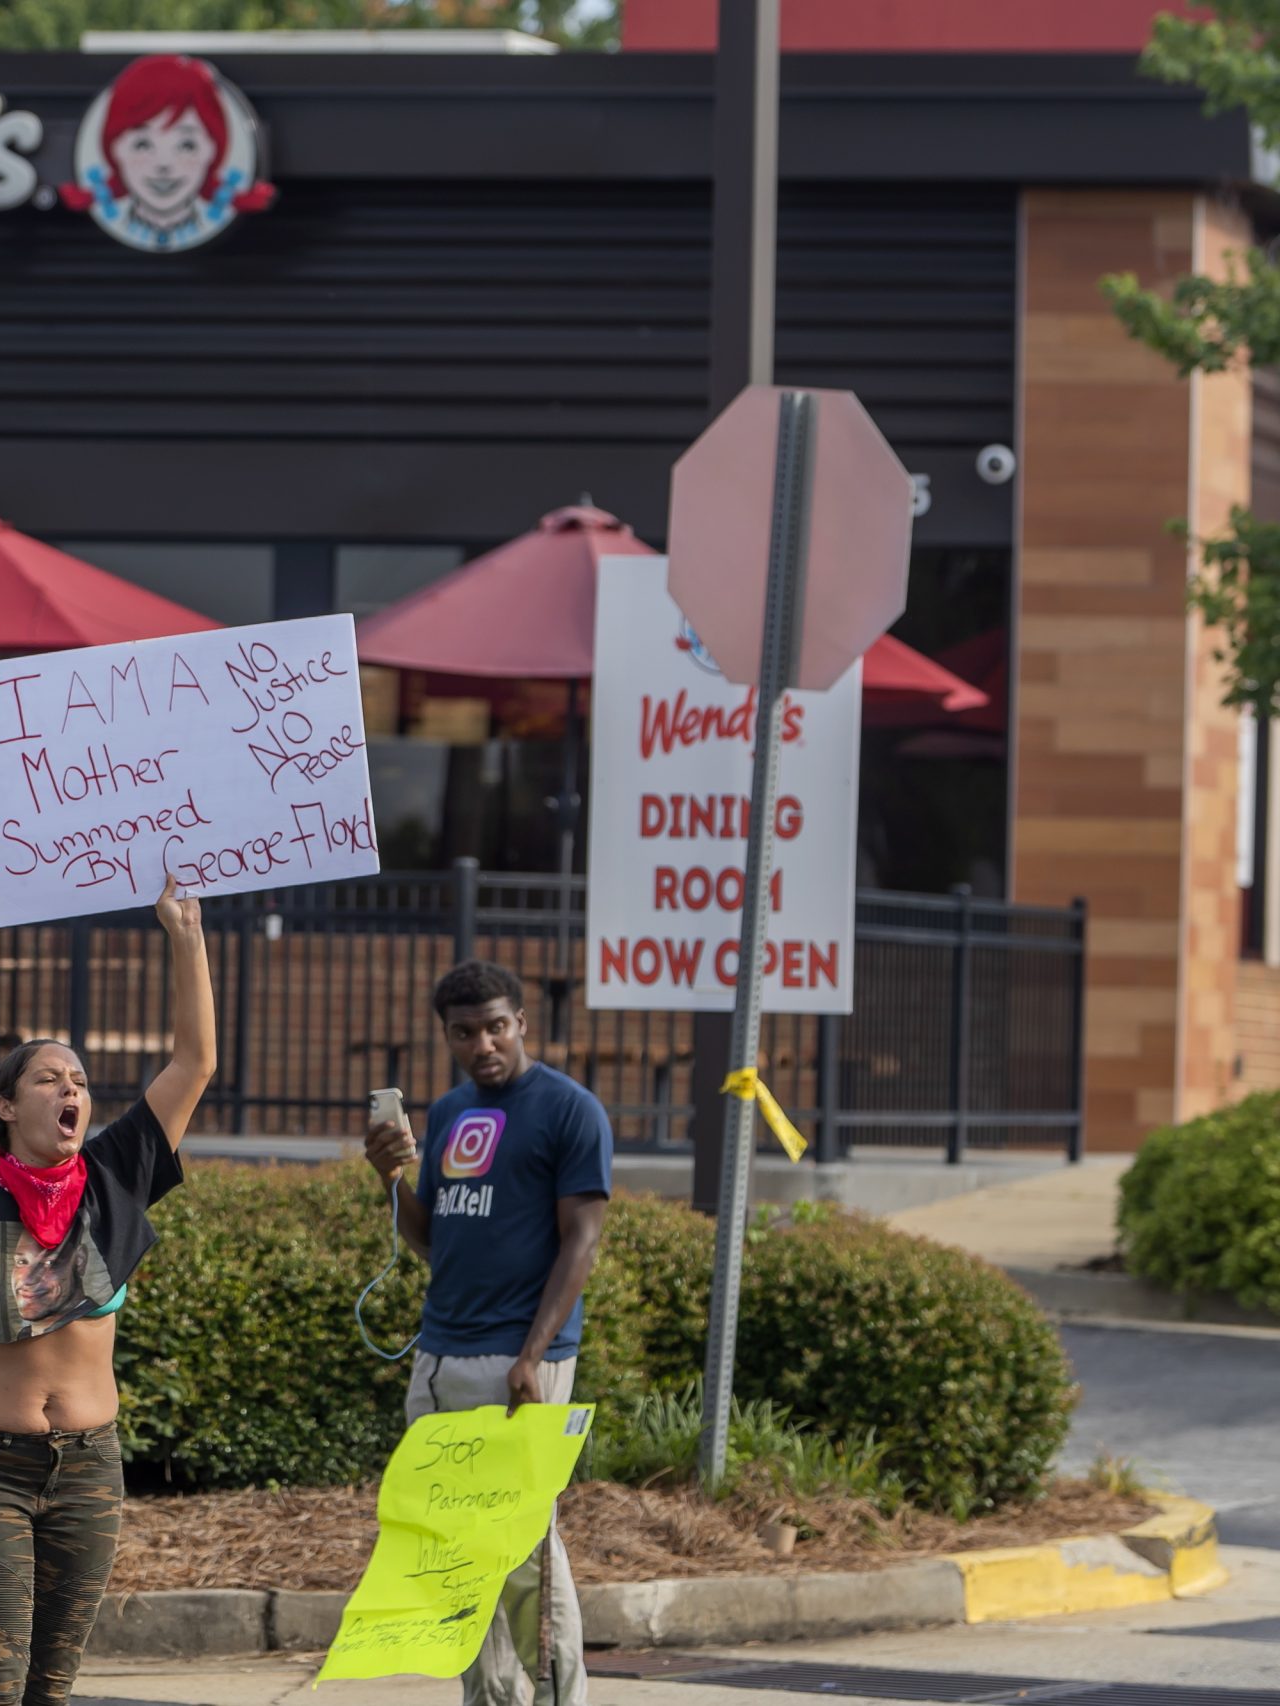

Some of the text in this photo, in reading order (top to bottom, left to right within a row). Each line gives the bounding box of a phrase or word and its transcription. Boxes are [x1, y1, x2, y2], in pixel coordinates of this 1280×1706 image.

[168, 651, 210, 712] A
[224, 641, 279, 688] NO
[247, 710, 314, 777] NO
[638, 684, 805, 761] Wend's
[20, 743, 180, 815] Mother
[269, 723, 367, 795] Peace
[1, 788, 213, 876] Summoned
[162, 831, 291, 890] George
[599, 937, 706, 987] NOW
[415, 1424, 486, 1474] Stop
